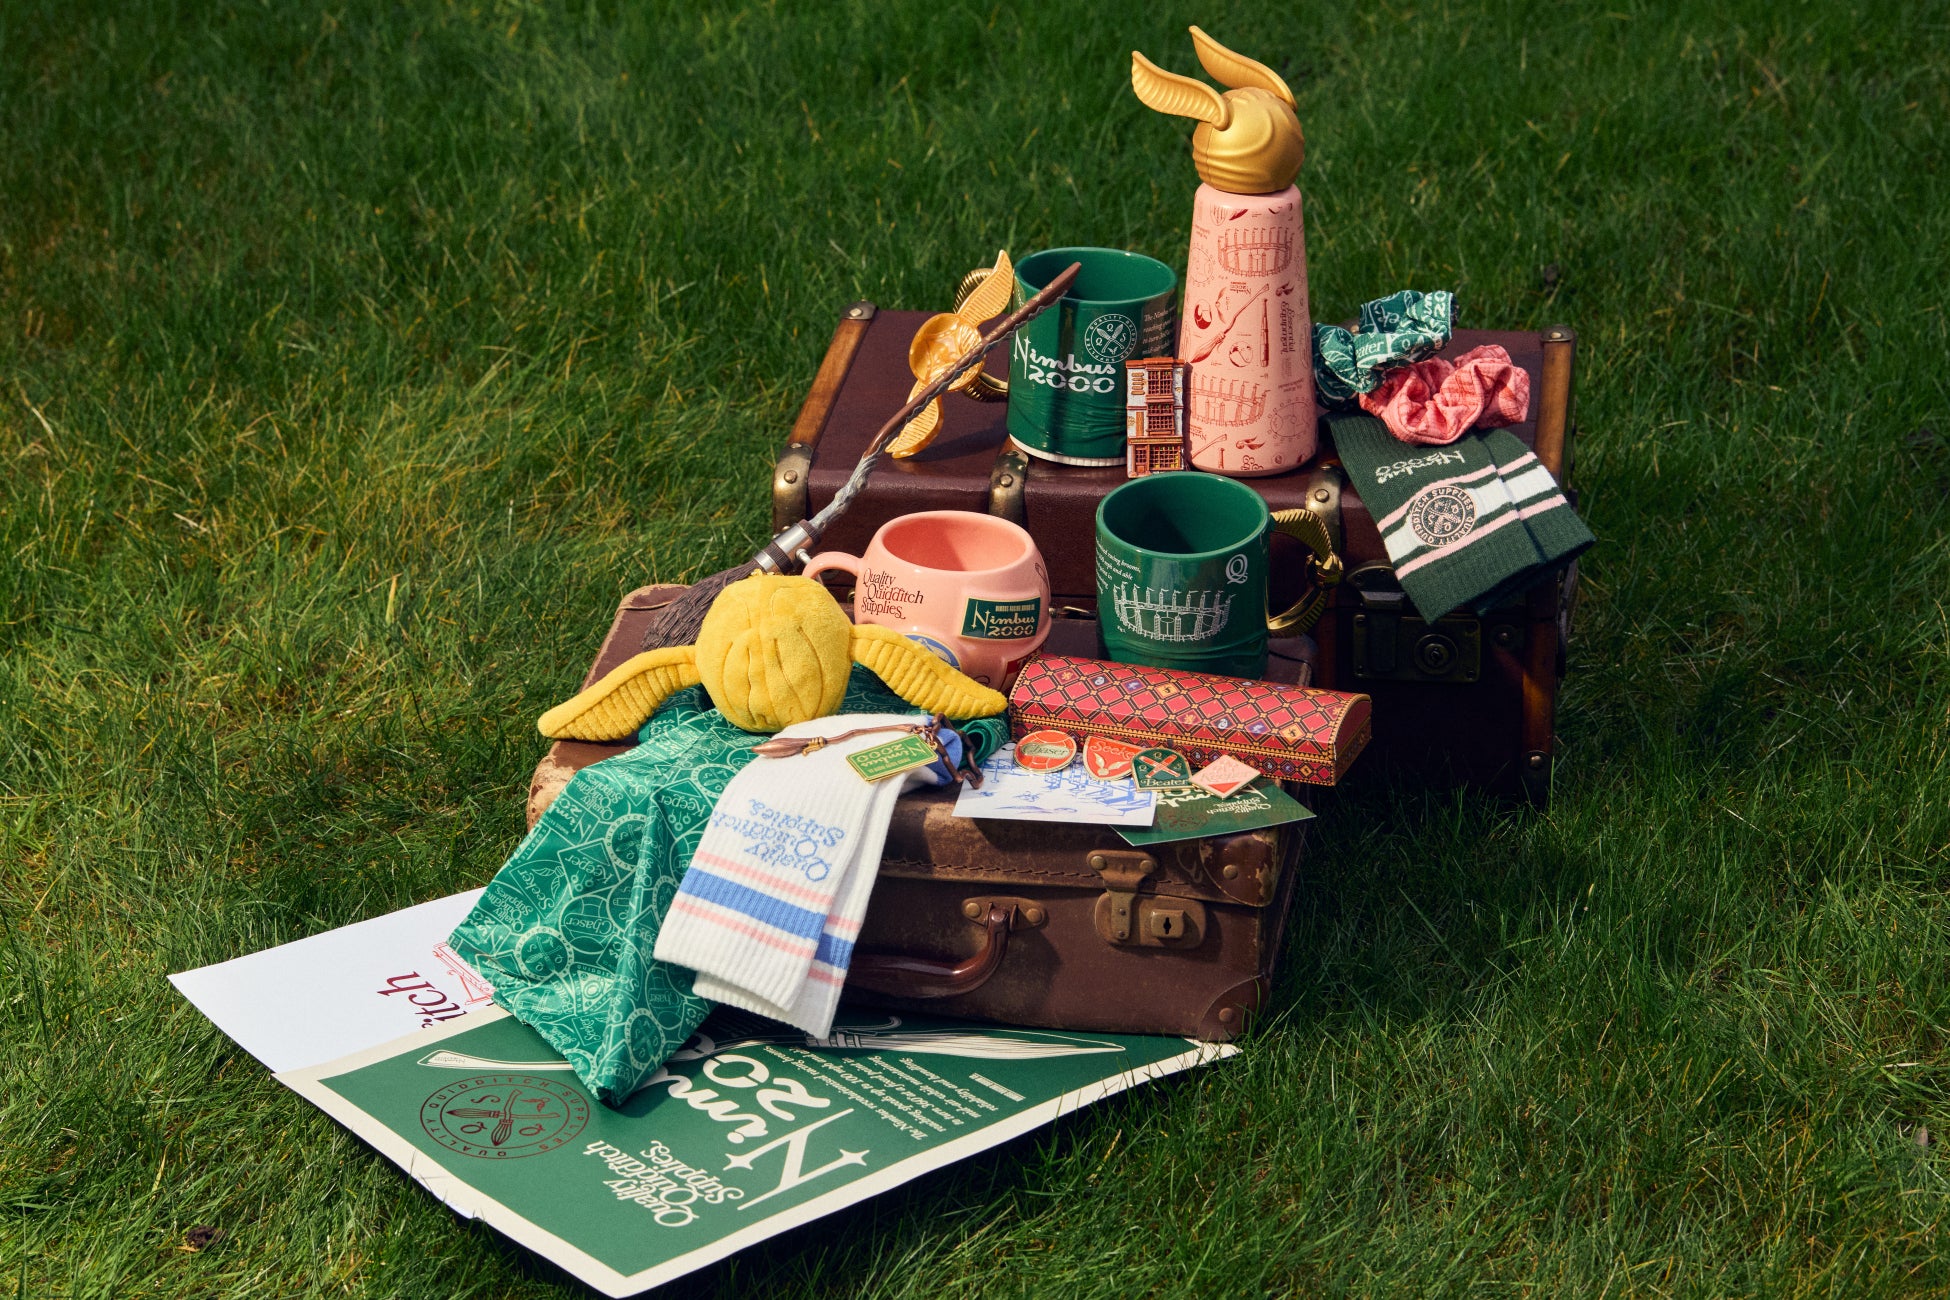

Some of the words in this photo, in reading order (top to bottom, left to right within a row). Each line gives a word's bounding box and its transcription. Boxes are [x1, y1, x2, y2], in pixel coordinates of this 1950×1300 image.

[1014, 330, 1116, 380] Nimbus
[1028, 364, 1116, 394] 2000
[1432, 488, 1474, 510] SUPPLIES
[1413, 495, 1434, 544] QUIDDITCH
[1439, 516, 1474, 545] QUALITY
[863, 568, 896, 590] Quality
[868, 583, 924, 604] Quidditch
[861, 596, 906, 620] Supplies
[971, 601, 1035, 637] Nimbus
[988, 625, 1034, 636] 2000
[855, 743, 904, 762] 2000
[860, 742, 926, 767] Nimbus
[1022, 743, 1068, 756] Chaser
[1090, 741, 1136, 760] Seeke
[585, 774, 623, 803] Supplies
[1145, 779, 1188, 787] Beater
[557, 796, 582, 817] 20
[580, 796, 612, 820] Quality
[659, 793, 706, 817] Keeper
[750, 799, 844, 847] Supplies
[564, 854, 612, 883] Keeper
[744, 842, 832, 882] Quality
[494, 885, 532, 914] Supplies
[517, 869, 553, 909] Seeker
[493, 908, 523, 932] Quality
[565, 917, 611, 934] Chaser
[429, 1077, 550, 1109] QUIDDITCH
[460, 1122, 488, 1134] Q
[518, 1123, 546, 1136] Q
[539, 1090, 585, 1151] SUPPLIES
[875, 1108, 912, 1130] Nimbus
[426, 1118, 507, 1157] QUALITY
[909, 1129, 927, 1139] The
[583, 1140, 704, 1206] Quidditch
[640, 1140, 745, 1204] Supplies
[603, 1180, 700, 1227] Quality
